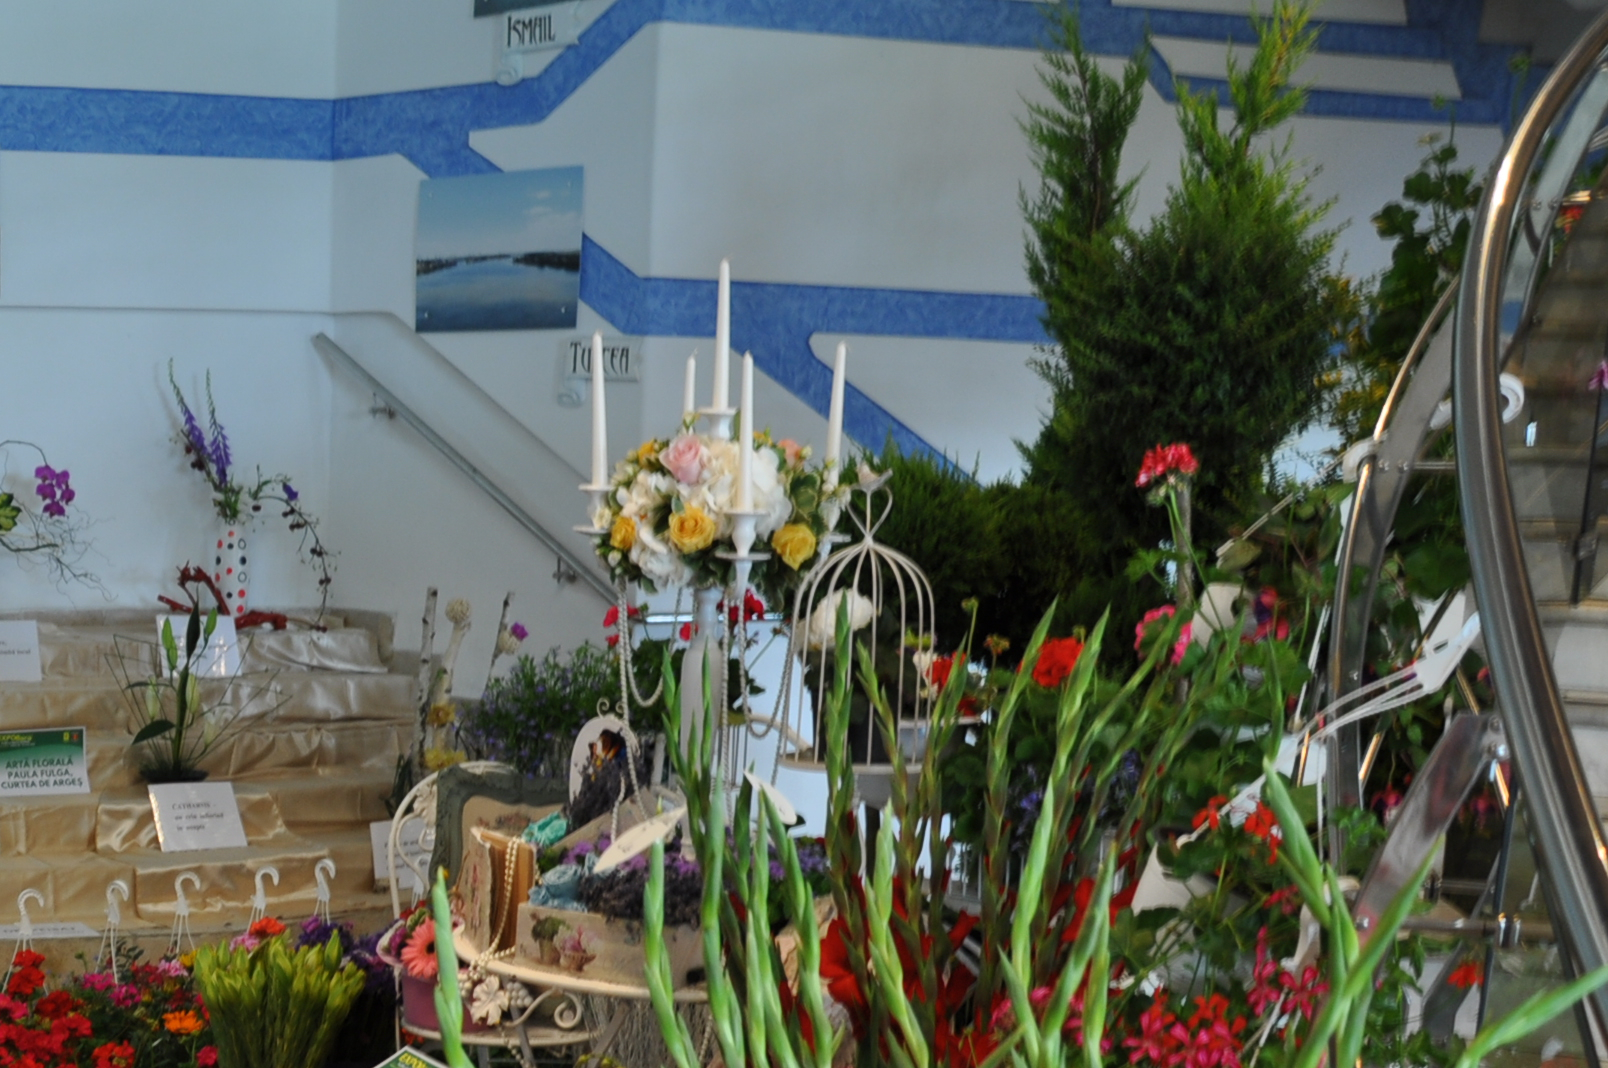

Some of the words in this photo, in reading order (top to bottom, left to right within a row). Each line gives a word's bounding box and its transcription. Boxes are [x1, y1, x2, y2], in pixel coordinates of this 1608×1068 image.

[507, 14, 556, 48] ISMAIL
[570, 341, 630, 376] TUCEA
[6, 757, 30, 770] ARTĂ
[32, 755, 73, 768] FLORALĂ
[7, 770, 38, 779] PAULA
[40, 768, 73, 778] FULGA,
[1, 780, 37, 790] CURTEA
[39, 779, 50, 788] DE
